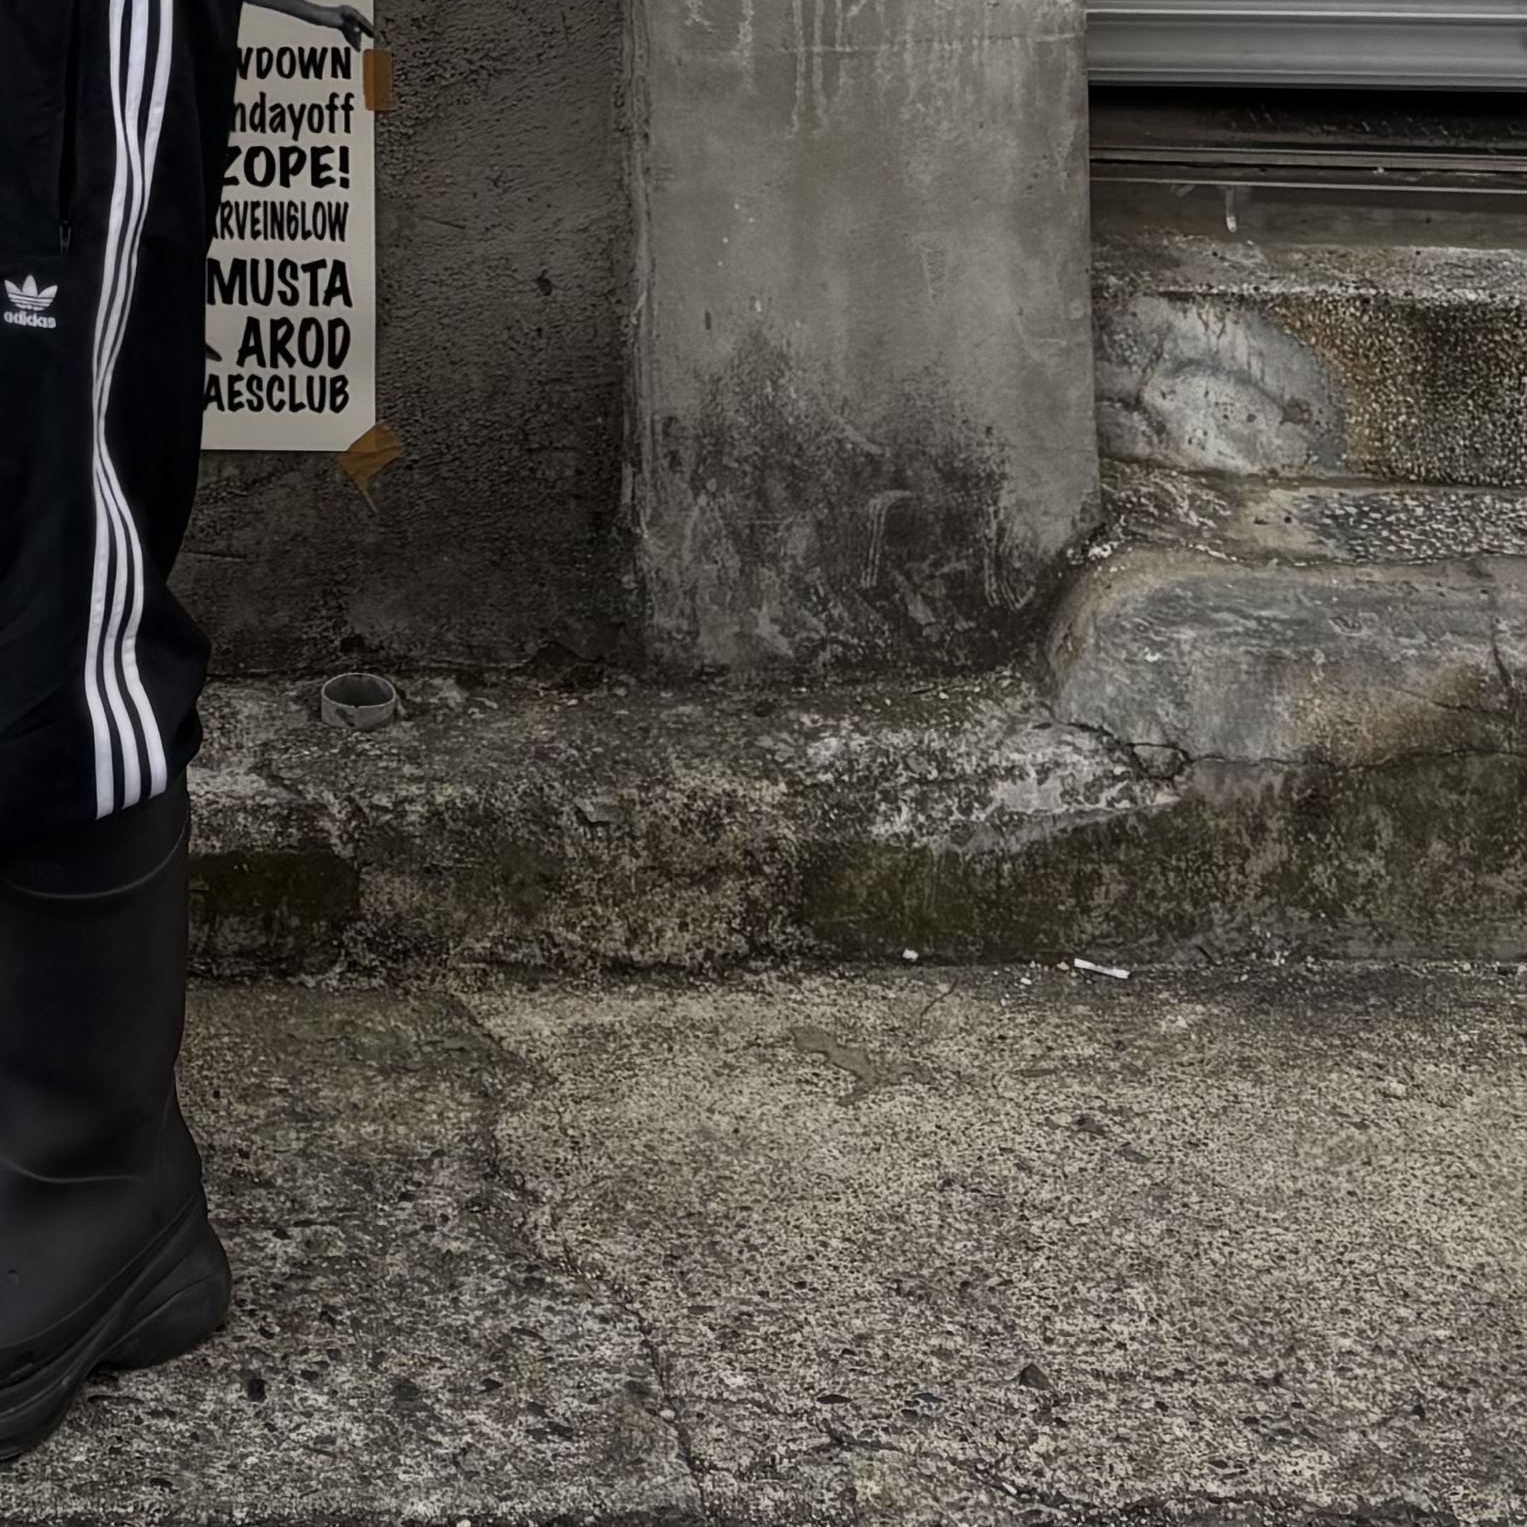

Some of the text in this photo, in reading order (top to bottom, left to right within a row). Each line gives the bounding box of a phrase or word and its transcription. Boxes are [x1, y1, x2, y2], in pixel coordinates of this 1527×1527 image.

[233, 91, 355, 142] ndayoff
[207, 257, 353, 308] MUSTA
[3, 310, 57, 329] adidas
[236, 316, 351, 370] AROD
[204, 373, 349, 414] AESCLUB
